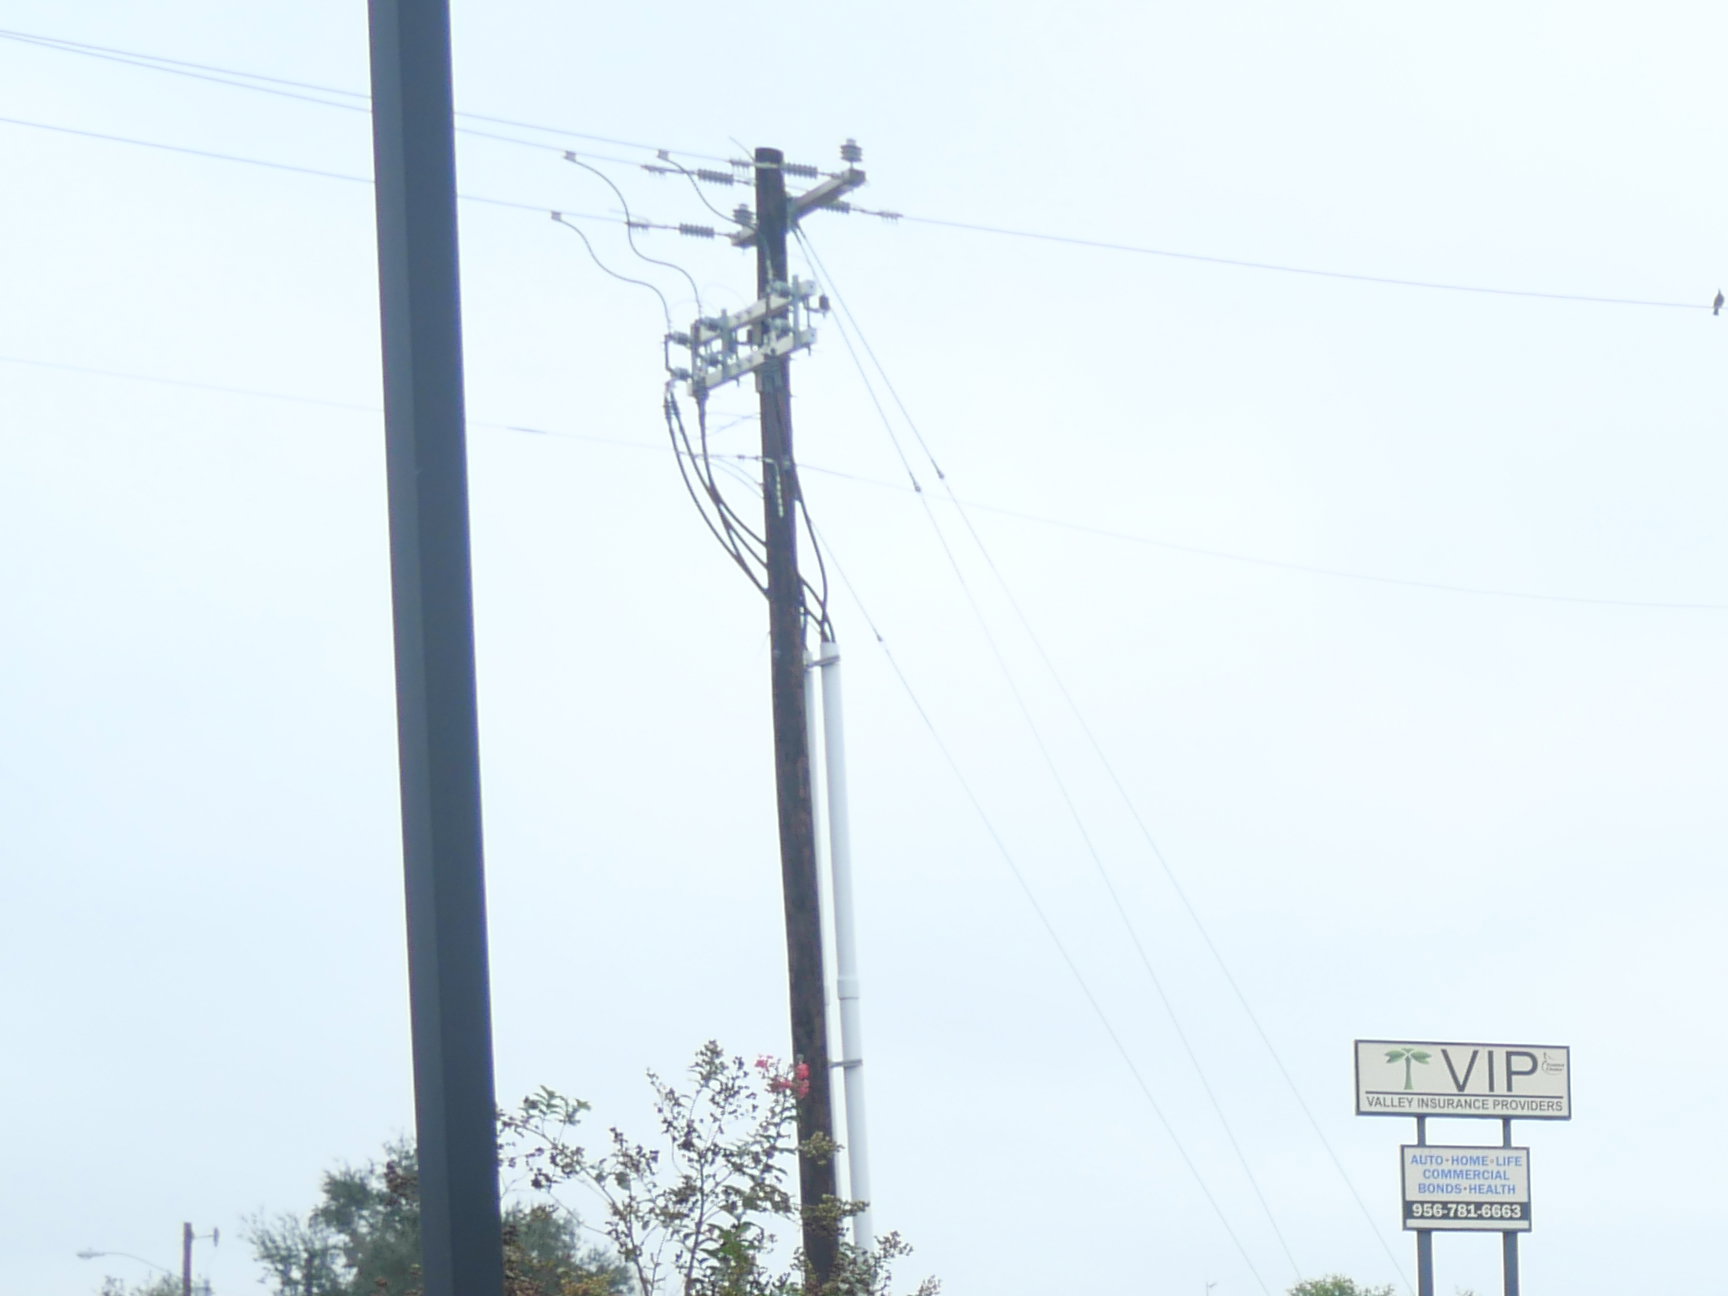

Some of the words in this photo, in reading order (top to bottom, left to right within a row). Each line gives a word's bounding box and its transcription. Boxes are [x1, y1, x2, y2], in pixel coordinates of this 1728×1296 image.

[1441, 1049, 1538, 1092] VIP
[1366, 1096, 1414, 1109] VALLEY
[1417, 1097, 1489, 1111] INSURANCE
[1493, 1099, 1563, 1112] PROVIDERS
[1411, 1155, 1443, 1166] AUTO
[1451, 1155, 1489, 1166] HOME
[1496, 1156, 1522, 1167] LIFE
[1423, 1168, 1510, 1181] COMMERCIAL
[1418, 1183, 1462, 1194] BONDS
[1468, 1184, 1516, 1195] HEALTH
[1412, 1203, 1521, 1218] 956-781-6663
